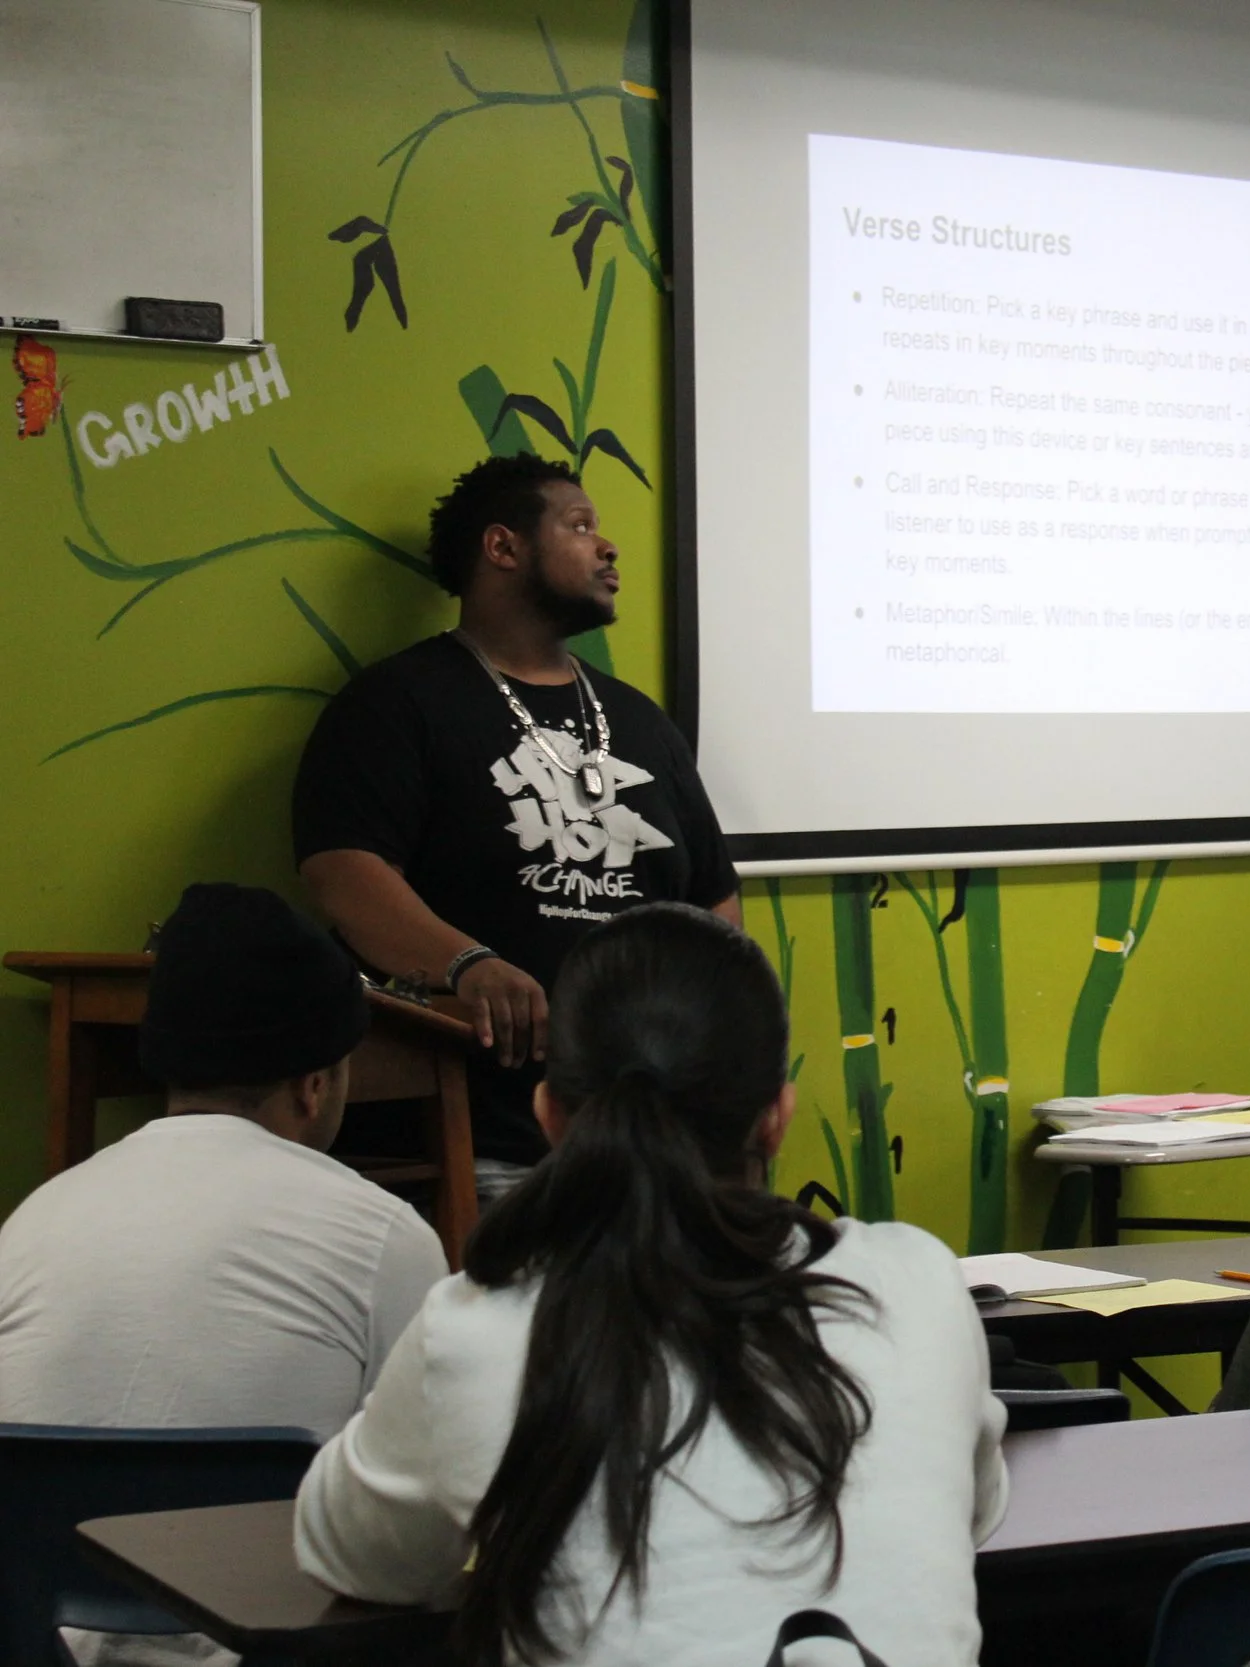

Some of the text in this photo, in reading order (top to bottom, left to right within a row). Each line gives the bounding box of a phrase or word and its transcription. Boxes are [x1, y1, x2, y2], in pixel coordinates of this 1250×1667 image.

[842, 206, 1072, 256] Verse Structures
[881, 285, 981, 316] Repetition:
[986, 295, 1025, 319] Pick
[1031, 303, 1041, 320] a
[1047, 301, 1077, 327] key
[1082, 304, 1142, 329] phrase
[1146, 311, 1178, 332] and
[1183, 315, 1213, 335] use
[1219, 313, 1228, 335] it
[1233, 314, 1247, 336] in
[882, 329, 950, 354] repeats
[956, 329, 972, 353] in
[978, 334, 1010, 361] key
[1016, 340, 1097, 363] moments
[1102, 343, 1194, 372] throughout
[1198, 351, 1223, 371] the
[884, 379, 983, 406] Alliteration:
[990, 386, 1056, 412] Repeat
[1060, 391, 1087, 413] the
[1093, 397, 1139, 417] same
[1145, 401, 1232, 422] consonant
[885, 422, 934, 442] piece
[939, 423, 987, 450] using
[993, 425, 1024, 447] this
[1031, 428, 1087, 451] device
[1093, 435, 1109, 452] or
[1115, 433, 1143, 458] key
[1149, 437, 1235, 459] sentences
[885, 471, 922, 495] Call
[927, 474, 960, 496] and
[966, 474, 1062, 503] Response:
[1067, 480, 1103, 503] Pick
[1109, 487, 1119, 503] a
[1125, 484, 1166, 505] word
[1171, 490, 1188, 507] or
[1193, 489, 1248, 511] phrase
[885, 511, 953, 534] listener
[957, 514, 974, 536] to
[980, 519, 1012, 537] use
[1018, 521, 1039, 538] as
[1044, 522, 1055, 538] a
[1060, 521, 1139, 544] response
[1145, 524, 1189, 543] when
[885, 549, 1012, 576] key moments.
[1044, 605, 1099, 628] Within
[1104, 607, 1130, 628] the
[1134, 607, 1173, 629] lines
[1178, 607, 1201, 632] (or
[1206, 609, 1231, 630] the
[885, 642, 1011, 669] metaphorical.
